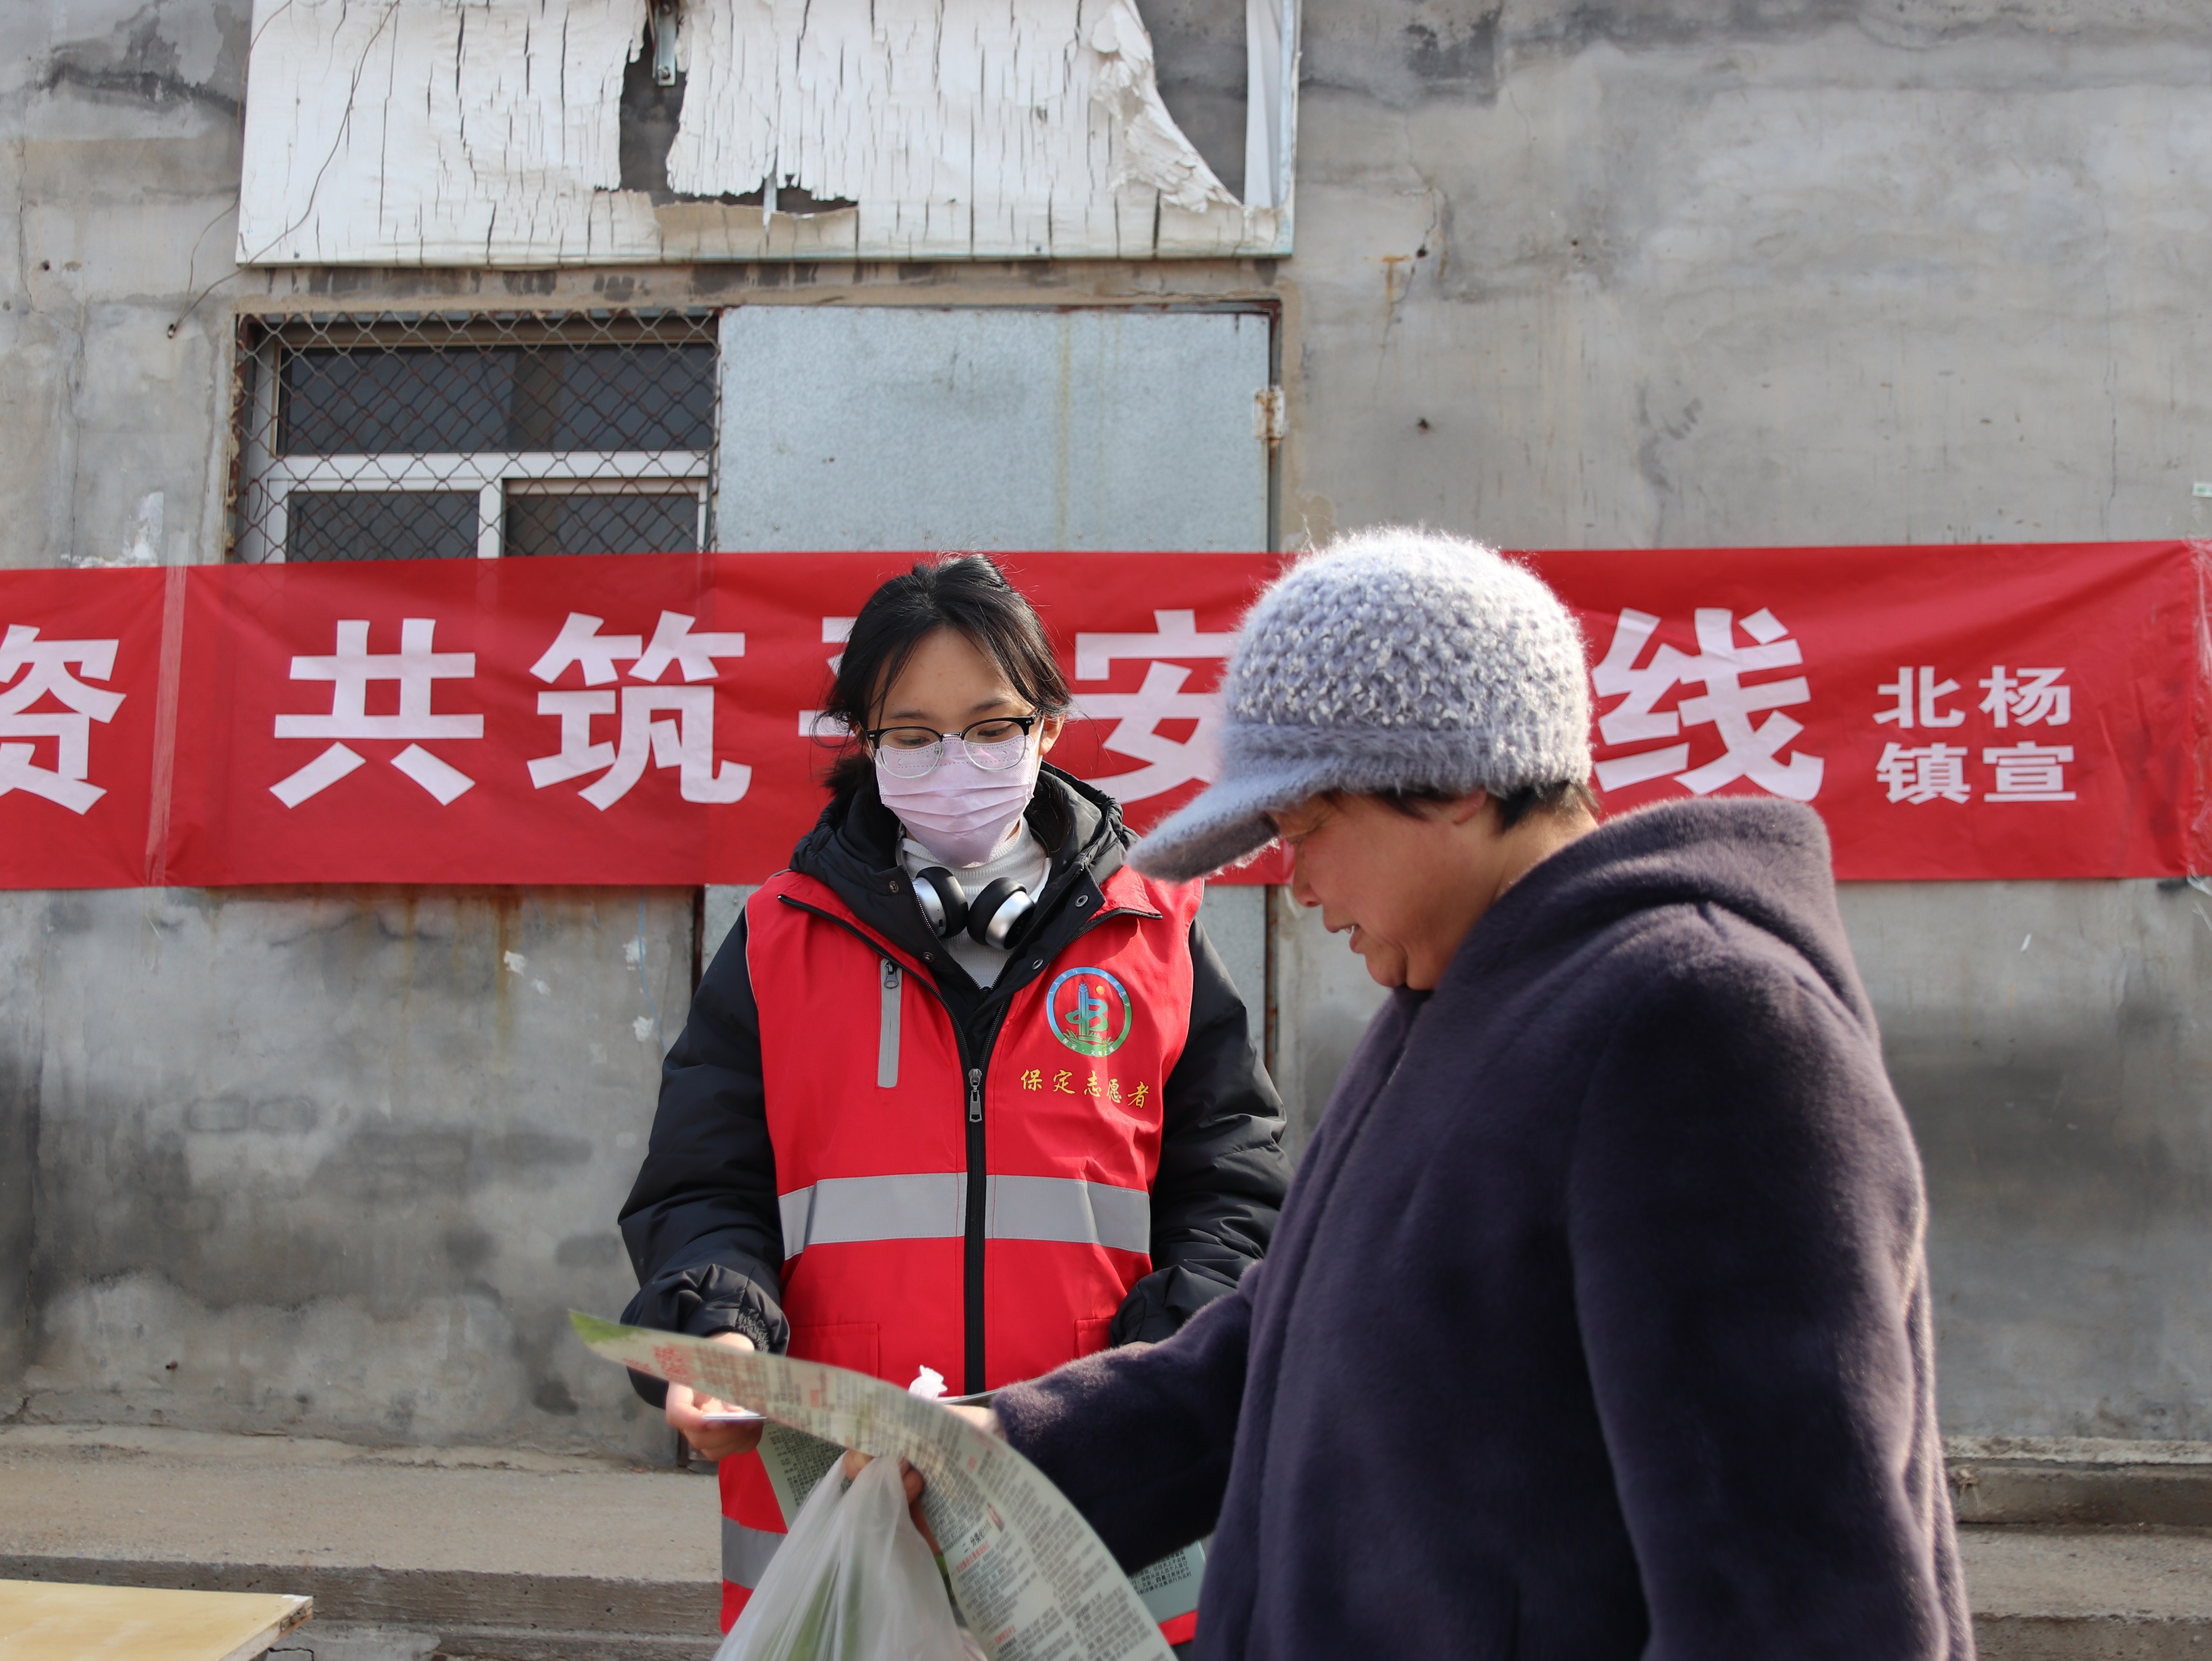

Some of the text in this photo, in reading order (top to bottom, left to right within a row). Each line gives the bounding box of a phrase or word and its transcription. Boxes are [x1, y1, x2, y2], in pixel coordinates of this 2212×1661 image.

[0, 623, 126, 816] 资
[1873, 665, 2071, 729] 北杨
[1877, 741, 2076, 805] 镇宣
[1020, 1068, 1150, 1109] 保定志愿者
